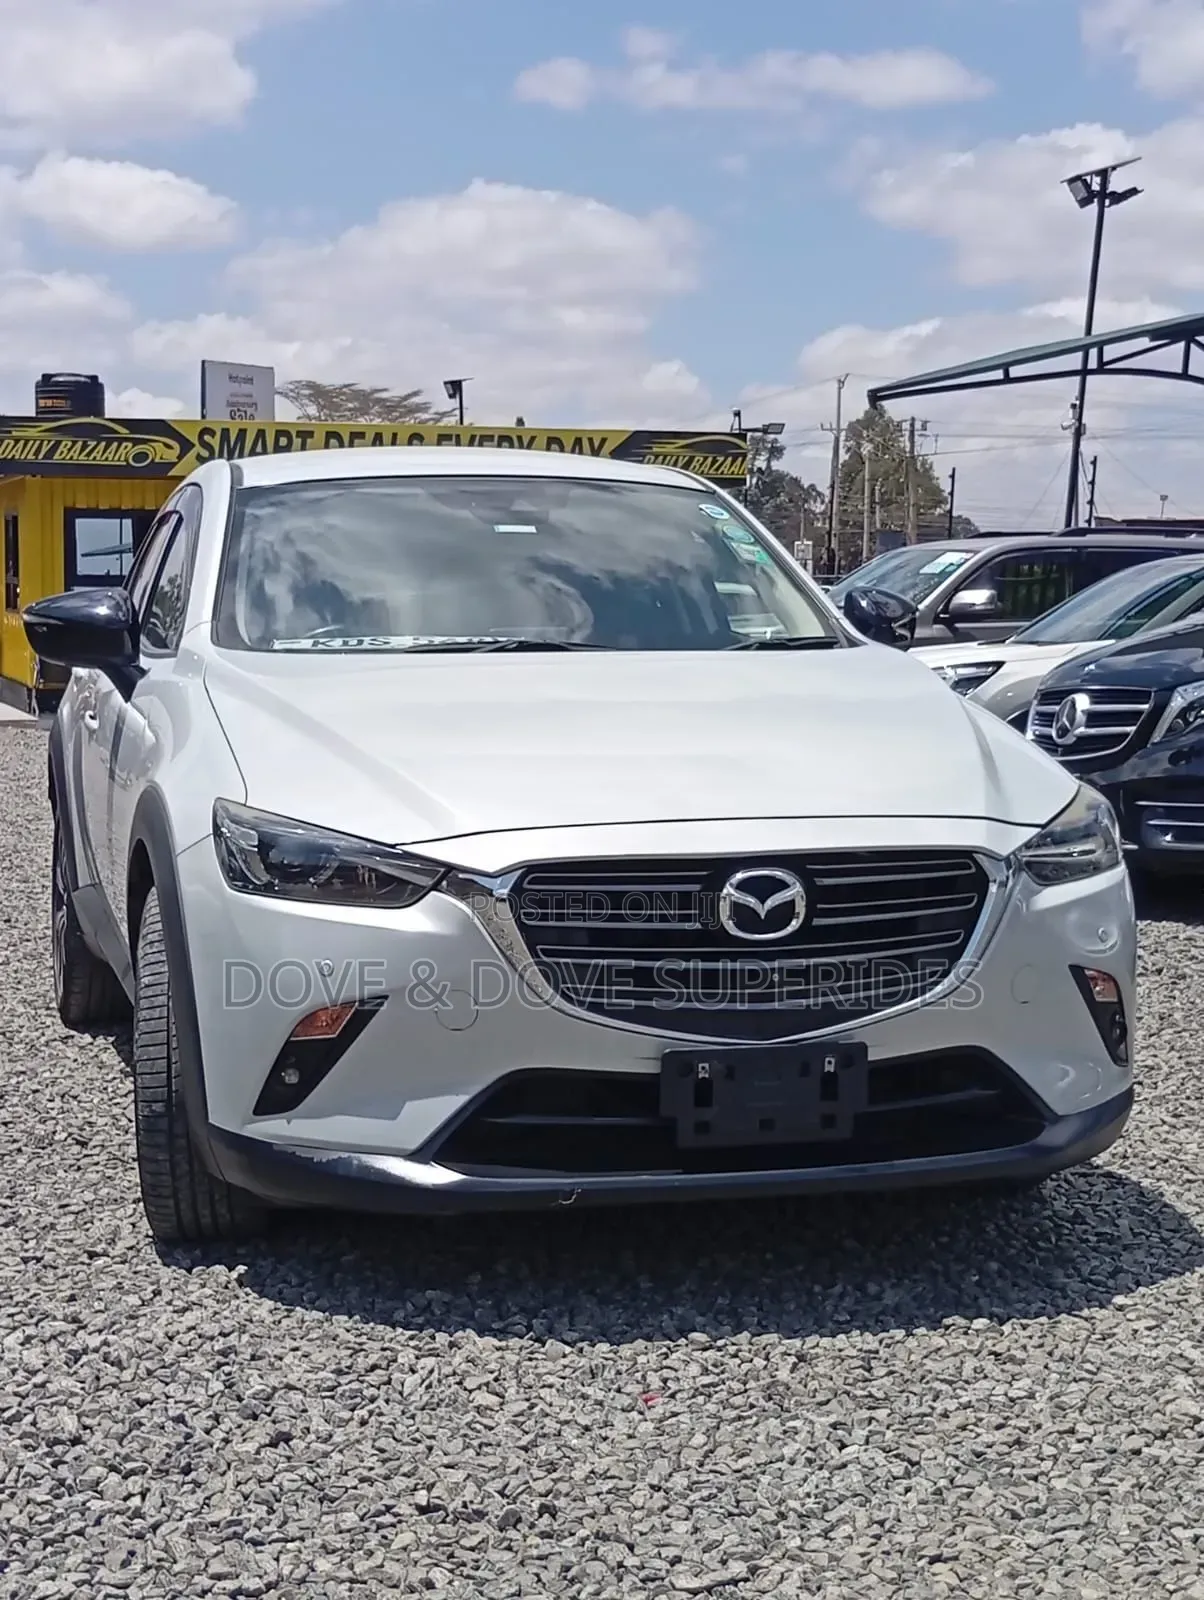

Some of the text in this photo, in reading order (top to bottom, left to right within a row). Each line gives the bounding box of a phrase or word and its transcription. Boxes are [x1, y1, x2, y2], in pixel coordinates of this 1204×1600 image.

[0, 439, 134, 461] DAILY BAZAAR
[195, 427, 315, 465] SMART
